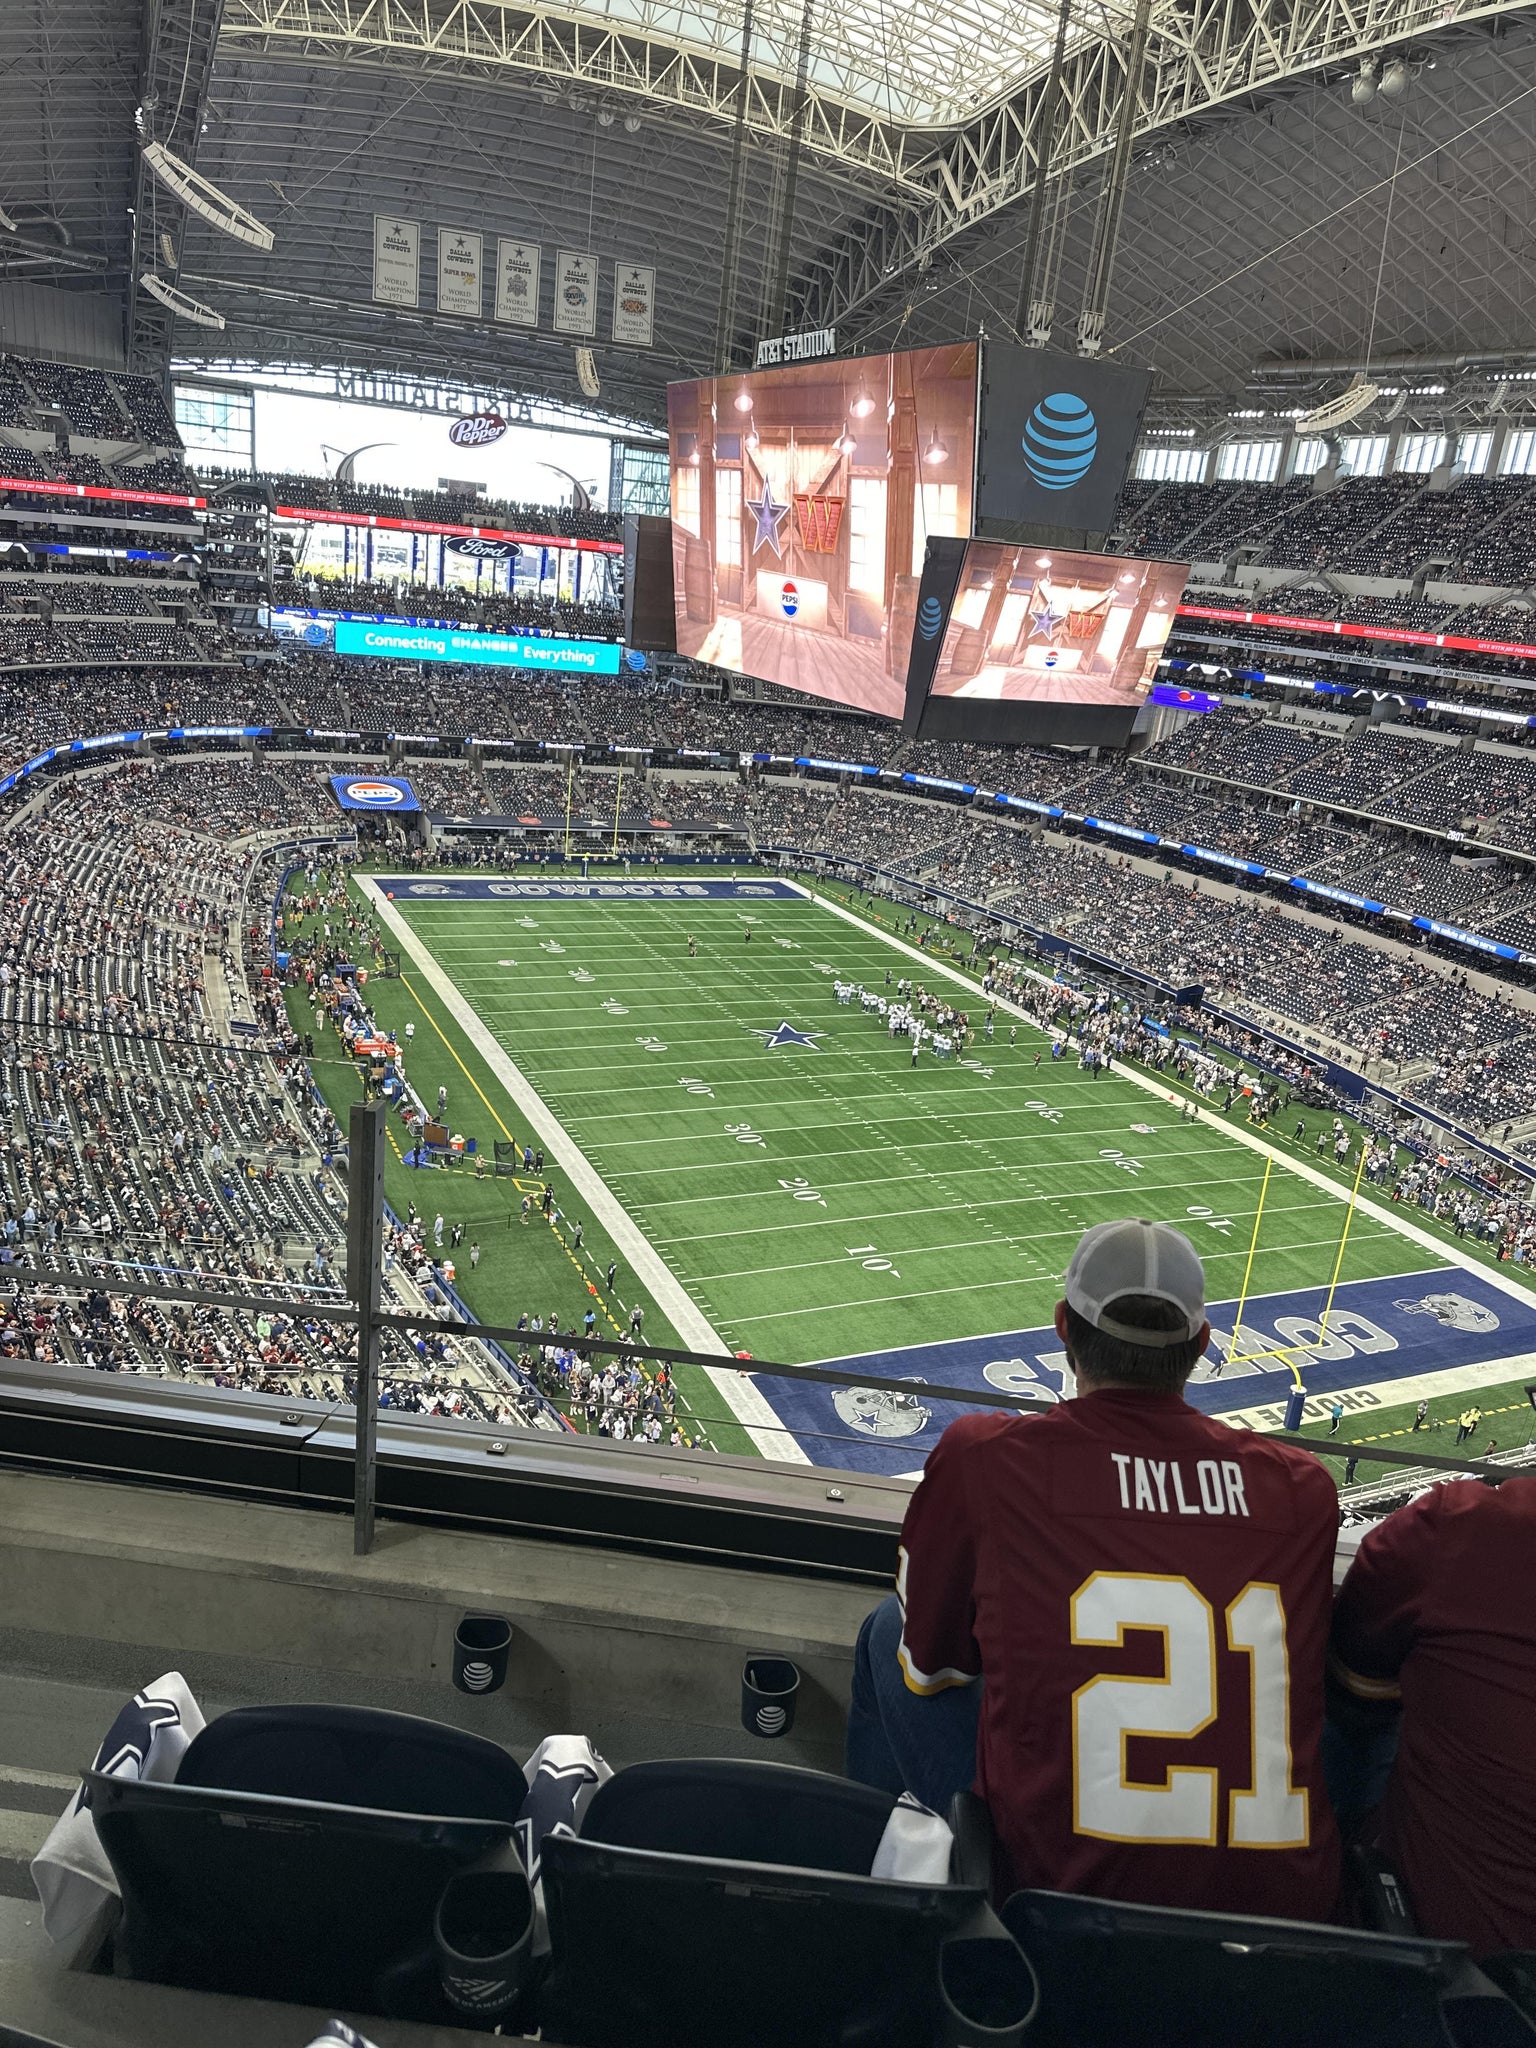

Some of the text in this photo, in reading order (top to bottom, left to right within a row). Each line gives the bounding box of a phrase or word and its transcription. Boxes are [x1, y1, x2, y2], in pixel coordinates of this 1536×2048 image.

[386, 237, 408, 245] DALLAS
[383, 243, 410, 253] COWBOYS
[449, 249, 471, 257] DALLAS
[447, 255, 473, 264] COWBOYS
[508, 259, 529, 267] DALLAS
[506, 265, 532, 274] COWBOYS
[567, 270, 587, 278] DALLAS
[384, 276, 408, 286] WORLD
[564, 276, 589, 285] COWBOYS
[625, 281, 645, 289] DALLAS
[377, 283, 415, 295] CHAMPIONS
[448, 289, 471, 297] WORLD
[442, 295, 478, 305] CHAMPIONS
[506, 297, 528, 306] WORLD
[499, 303, 534, 314] CHAMPIONS
[564, 308, 586, 316] WORLD
[558, 314, 592, 325] CHAMPIONS
[623, 318, 643, 327] WORLD
[617, 325, 649, 335] CHAMPIONS
[757, 328, 835, 365] AT&T STADIUM
[472, 416, 494, 432] Dr
[456, 418, 504, 443] Pepper
[793, 494, 845, 554] W
[460, 539, 508, 557] Ford
[782, 594, 798, 604] PEPSI
[1363, 628, 1374, 636] GIVE
[1375, 630, 1387, 638] WITH
[1395, 632, 1405, 640] FOR
[365, 632, 446, 654] Connecting
[523, 646, 595, 665] Everything
[1478, 643, 1490, 651] GIVE
[1491, 644, 1505, 652] WITH
[1503, 645, 1514, 653] JOY
[1514, 646, 1524, 654] FOR
[1454, 671, 1480, 680] MEREDITH
[314, 730, 360, 738] Blockchain.com
[395, 734, 439, 742] Blockchain.com
[472, 738, 514, 746] Blockchain.com
[488, 884, 709, 897] COWBOYS
[1307, 882, 1316, 891] We
[1316, 885, 1332, 896] salute
[1338, 893, 1350, 903] who
[1349, 898, 1365, 907] serve
[1431, 923, 1440, 931] We
[1441, 928, 1458, 939] salute
[1466, 936, 1479, 946] who
[1480, 941, 1497, 952] serve
[568, 967, 596, 982] 30
[600, 1001, 629, 1015] 40
[635, 1036, 668, 1052] 50
[676, 1077, 711, 1094] 40
[1024, 1101, 1064, 1119] 30
[723, 1123, 762, 1143] 30
[1098, 1149, 1144, 1169] 20
[777, 1177, 822, 1201] 20
[1186, 1205, 1236, 1230] 10
[844, 1243, 893, 1271] 10
[1110, 1452, 1250, 1518] TAYLOR
[1070, 1570, 1310, 1849] 21
